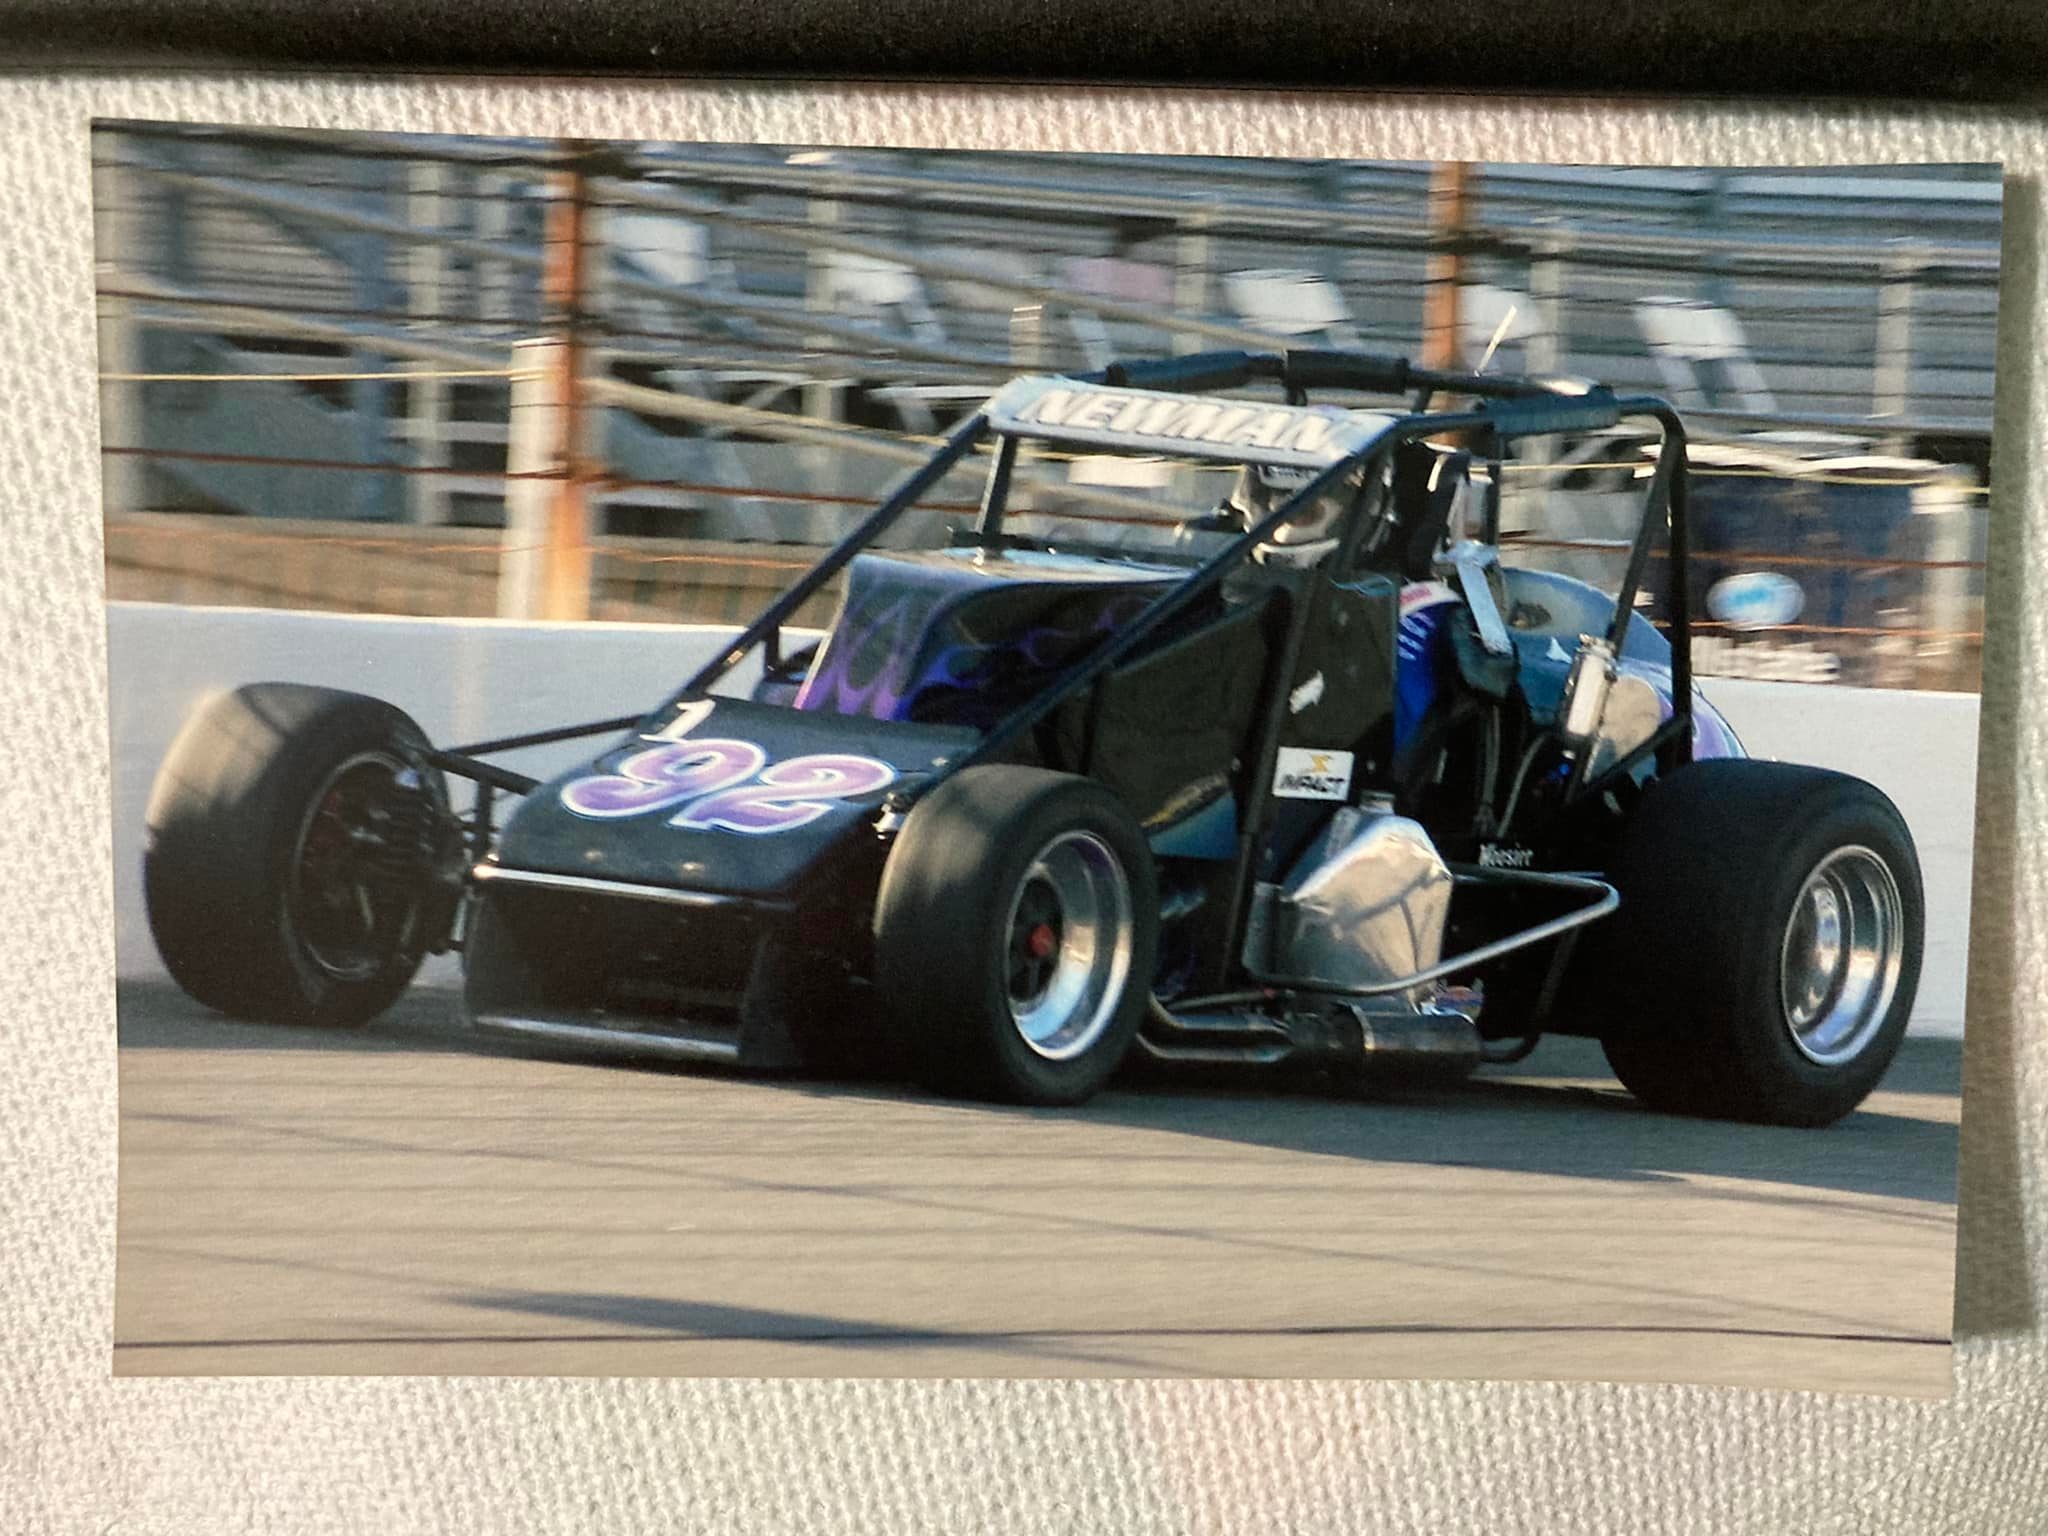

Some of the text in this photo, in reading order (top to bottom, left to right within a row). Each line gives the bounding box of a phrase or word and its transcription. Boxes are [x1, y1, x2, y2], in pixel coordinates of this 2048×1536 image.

[1013, 388, 1354, 453] NEWMAN
[639, 699, 717, 744] 1
[560, 738, 898, 836] 92
